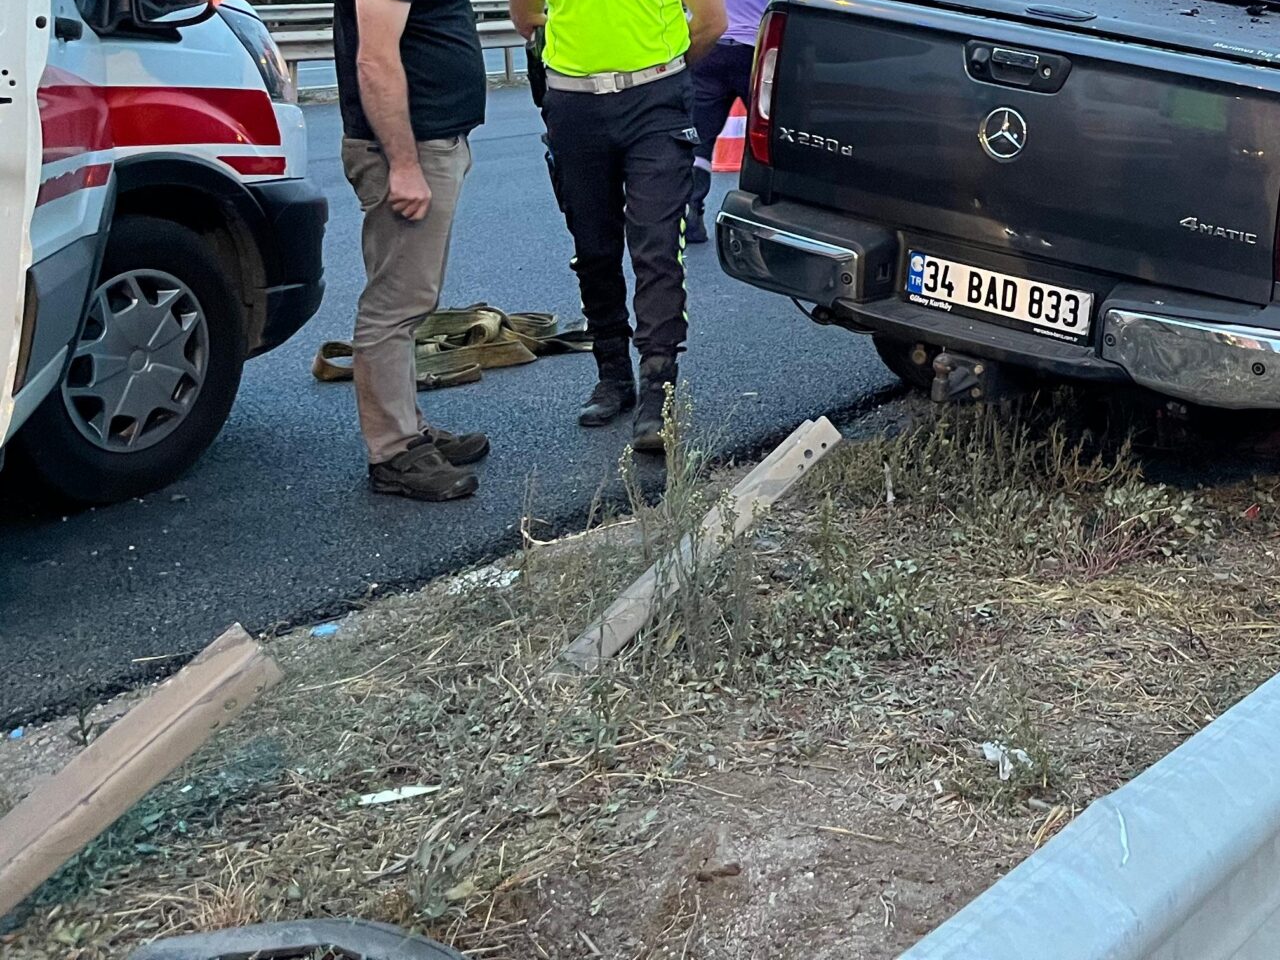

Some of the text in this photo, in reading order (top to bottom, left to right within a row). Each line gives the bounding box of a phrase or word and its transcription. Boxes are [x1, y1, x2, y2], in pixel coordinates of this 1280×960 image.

[1180, 216, 1257, 245] 4MATIC
[911, 274, 922, 286] TR
[924, 260, 1080, 328] 34 BAD 833
